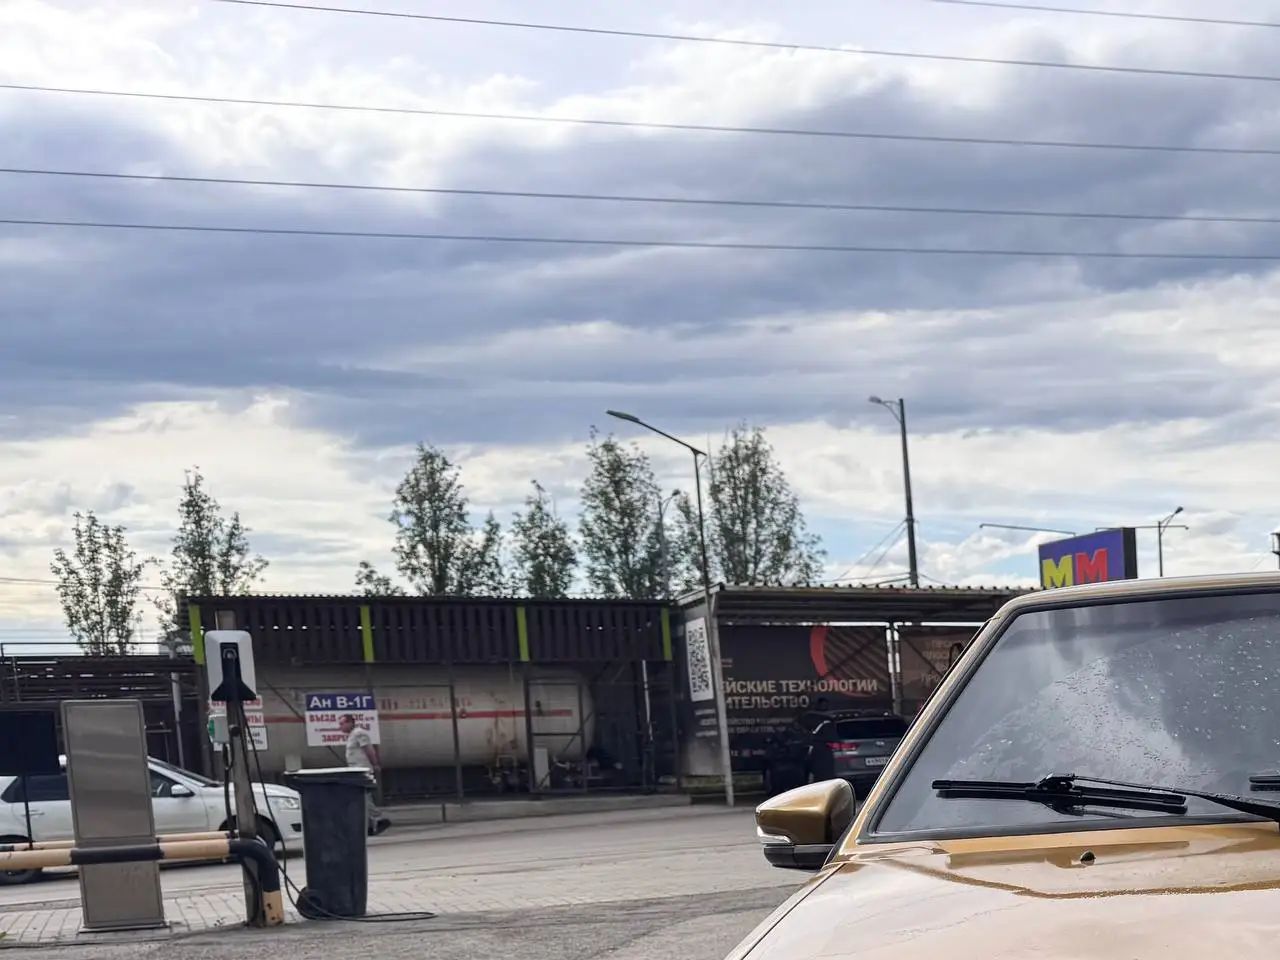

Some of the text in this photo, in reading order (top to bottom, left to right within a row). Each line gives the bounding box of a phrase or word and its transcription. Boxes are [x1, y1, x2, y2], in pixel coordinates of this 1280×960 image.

[722, 677, 878, 693] ЙСКИЕ ТЕХНОЛОГИИ
[309, 695, 332, 709] Ан
[336, 695, 372, 709] В-1Г
